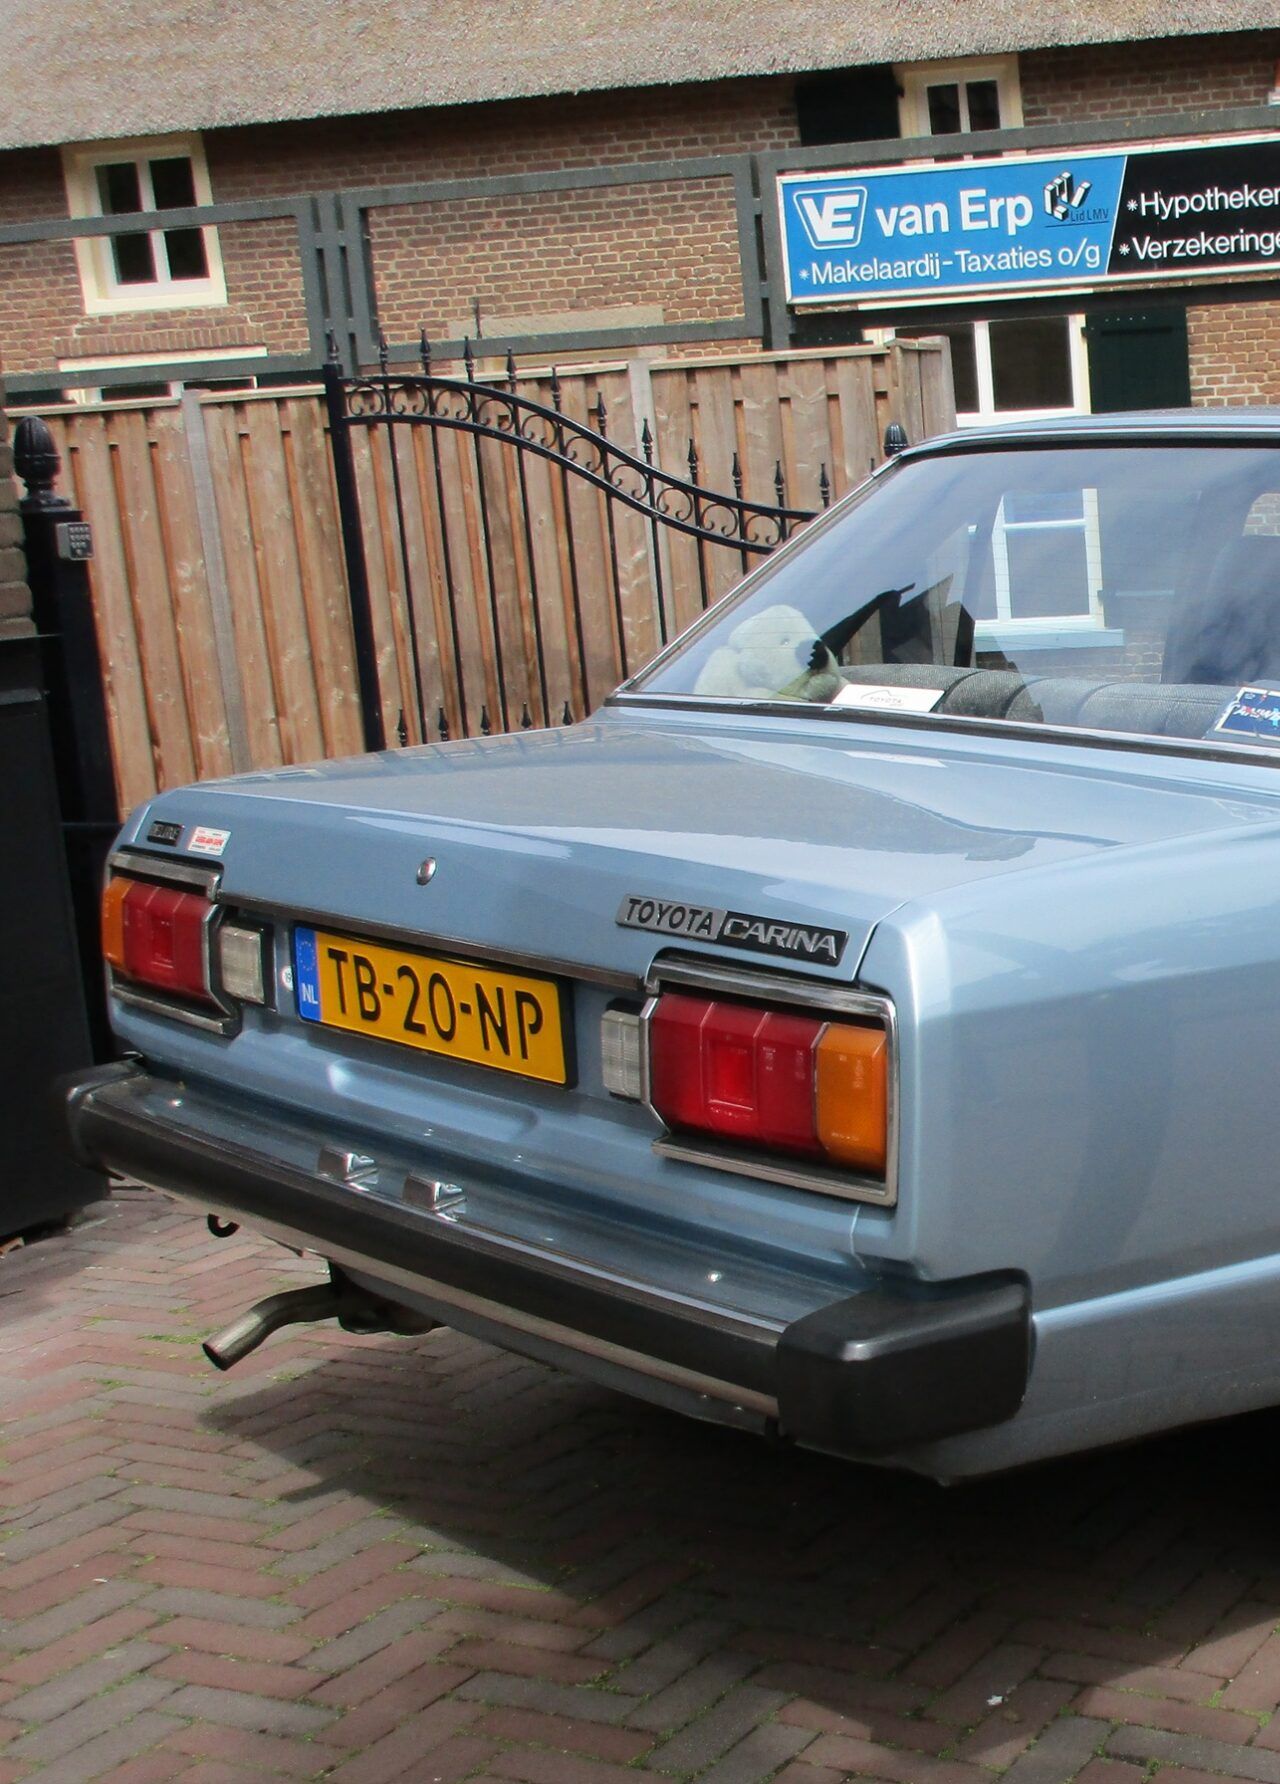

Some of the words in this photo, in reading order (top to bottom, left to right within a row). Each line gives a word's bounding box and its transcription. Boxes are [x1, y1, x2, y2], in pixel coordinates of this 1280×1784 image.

[875, 200, 950, 237] van
[960, 188, 1033, 236] Erp
[1070, 210, 1086, 222] Lid
[1086, 208, 1110, 221] LMV
[1057, 238, 1100, 268] o/g
[625, 898, 714, 935] TOYOTA
[723, 918, 838, 959] CARINA
[302, 982, 319, 1005] NL
[327, 947, 544, 1060] TB-20-NP
